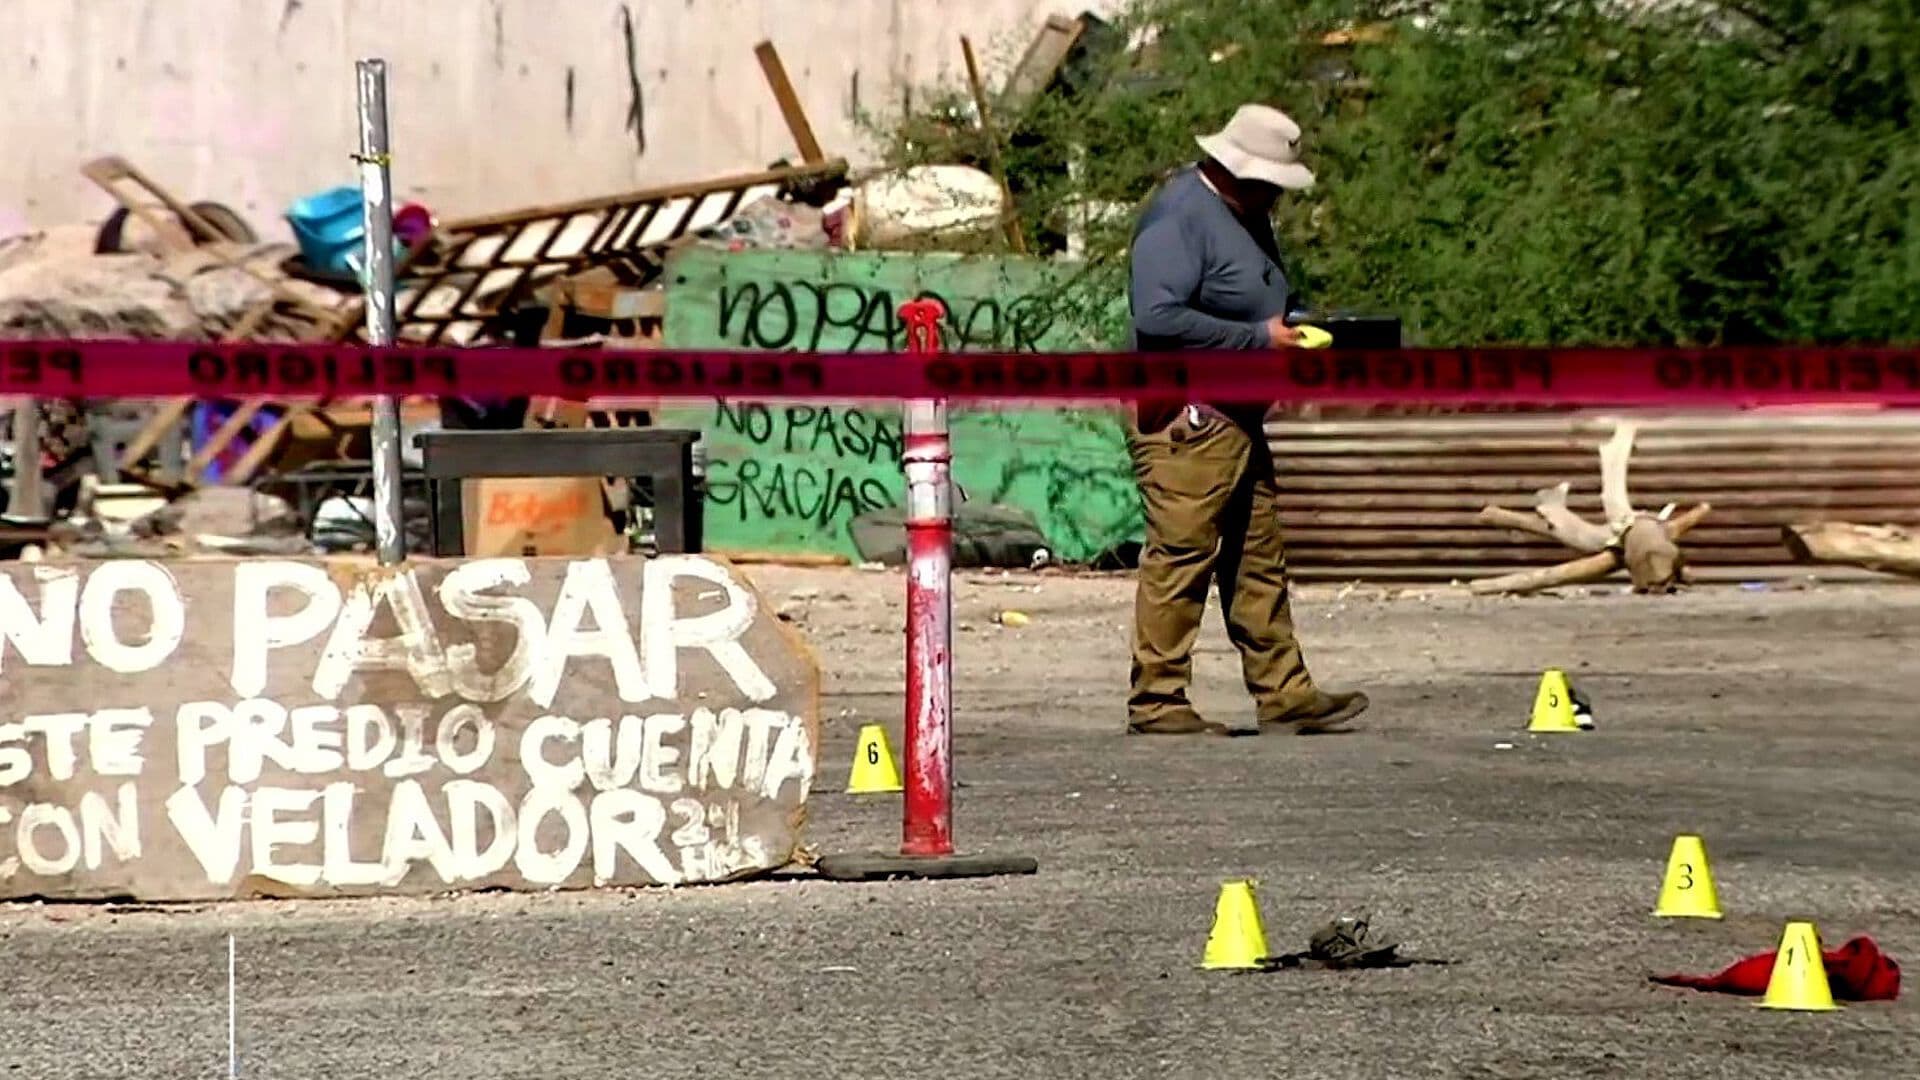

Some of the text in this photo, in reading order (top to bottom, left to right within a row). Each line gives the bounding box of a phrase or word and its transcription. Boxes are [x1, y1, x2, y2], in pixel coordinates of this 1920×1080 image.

[716, 395, 905, 473] NO PASA
[703, 459, 897, 526] GRACIAS
[0, 557, 777, 708] NO PASAR
[1548, 687, 1559, 708] 5
[176, 698, 496, 784] PREDIO
[520, 706, 815, 804] CUENTA
[867, 741, 879, 765] 6
[0, 781, 141, 879] ON
[165, 780, 685, 889] VELADOR
[1676, 863, 1694, 890] 3
